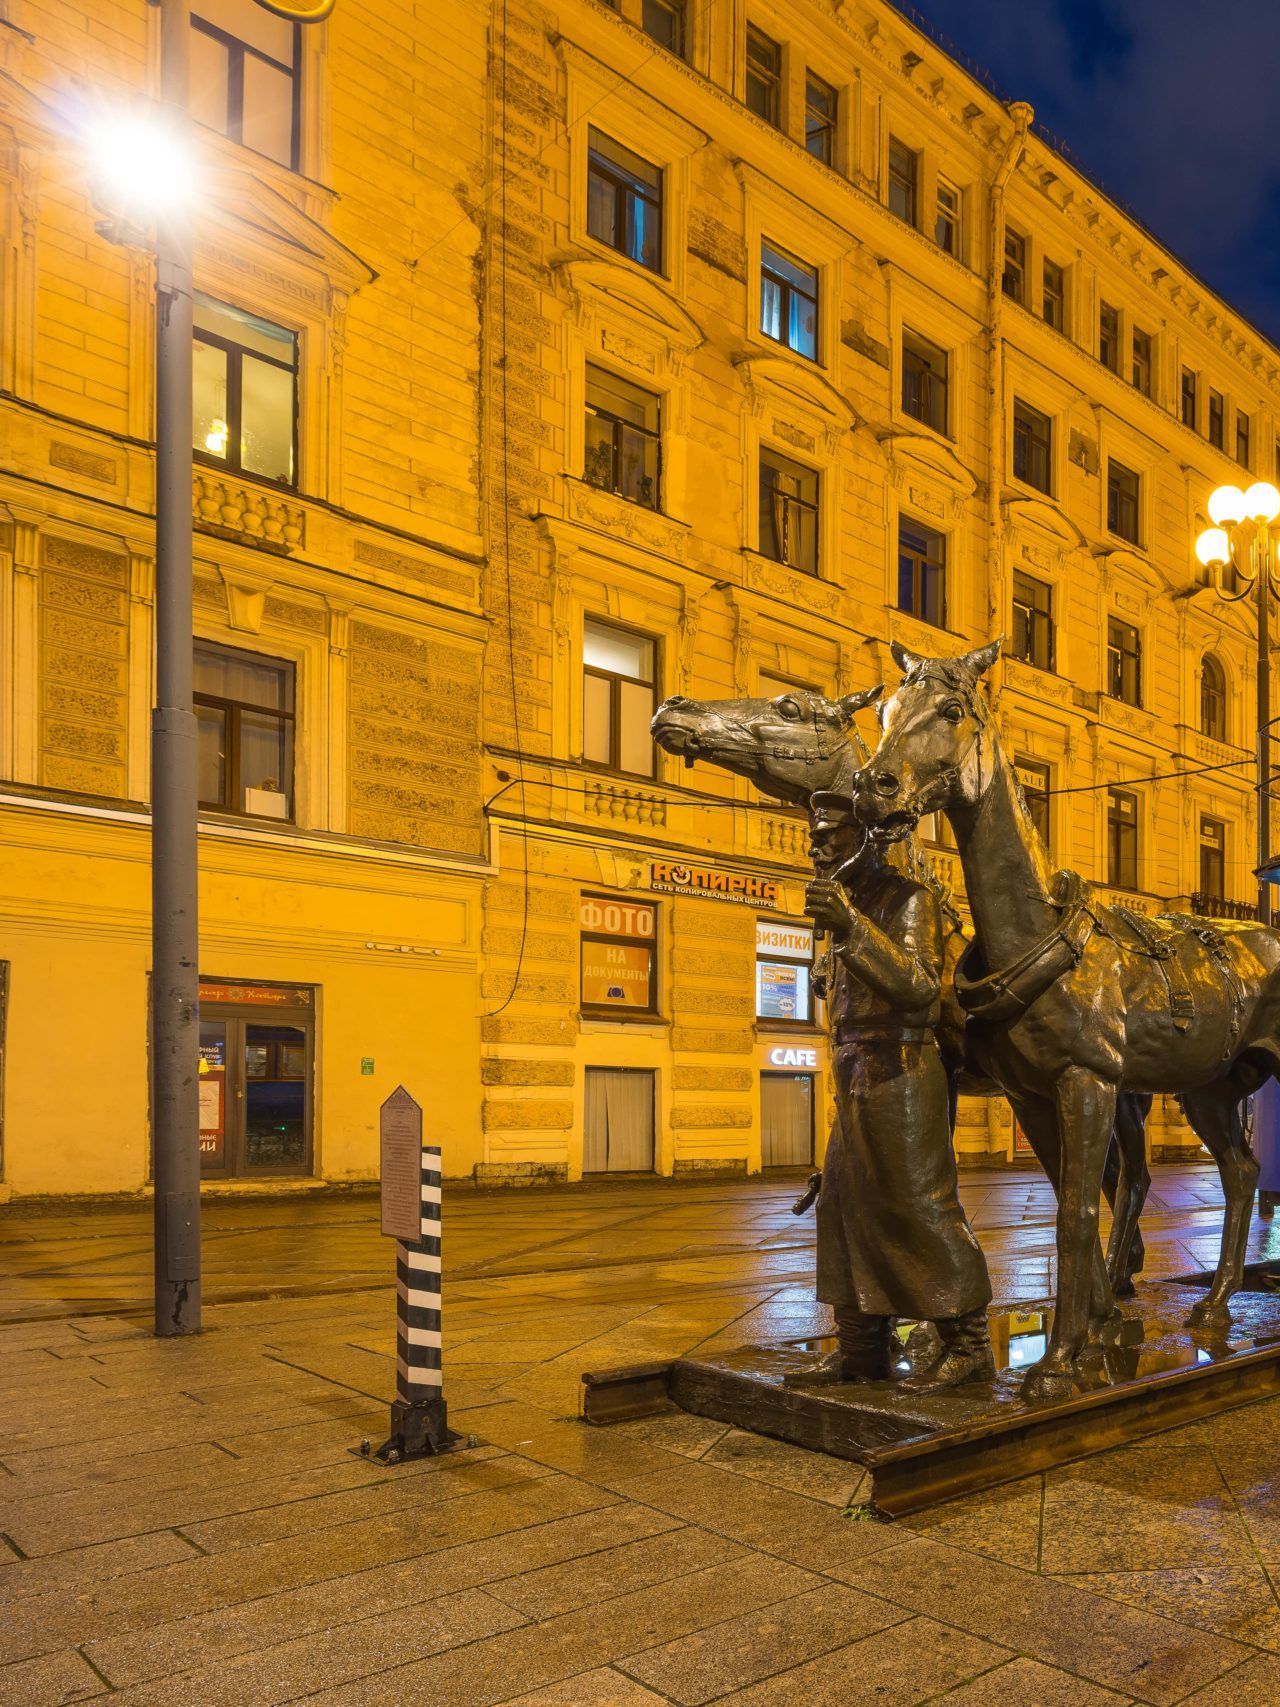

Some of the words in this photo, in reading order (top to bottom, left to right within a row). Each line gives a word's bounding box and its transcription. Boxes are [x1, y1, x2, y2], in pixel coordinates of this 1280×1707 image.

[652, 864, 779, 898] КОПИРКА
[652, 882, 674, 892] СЕТЬ
[675, 885, 744, 903] КОПИРОВАЛЬНЫХ
[745, 897, 779, 908] ЦЕНТРОВ
[580, 901, 654, 936] ФОТО
[756, 930, 810, 950] ВИЗИТКИ
[606, 948, 627, 965] НА
[584, 965, 649, 981] ДОКУМЕНТЫ
[770, 1048, 817, 1067] CAFE
